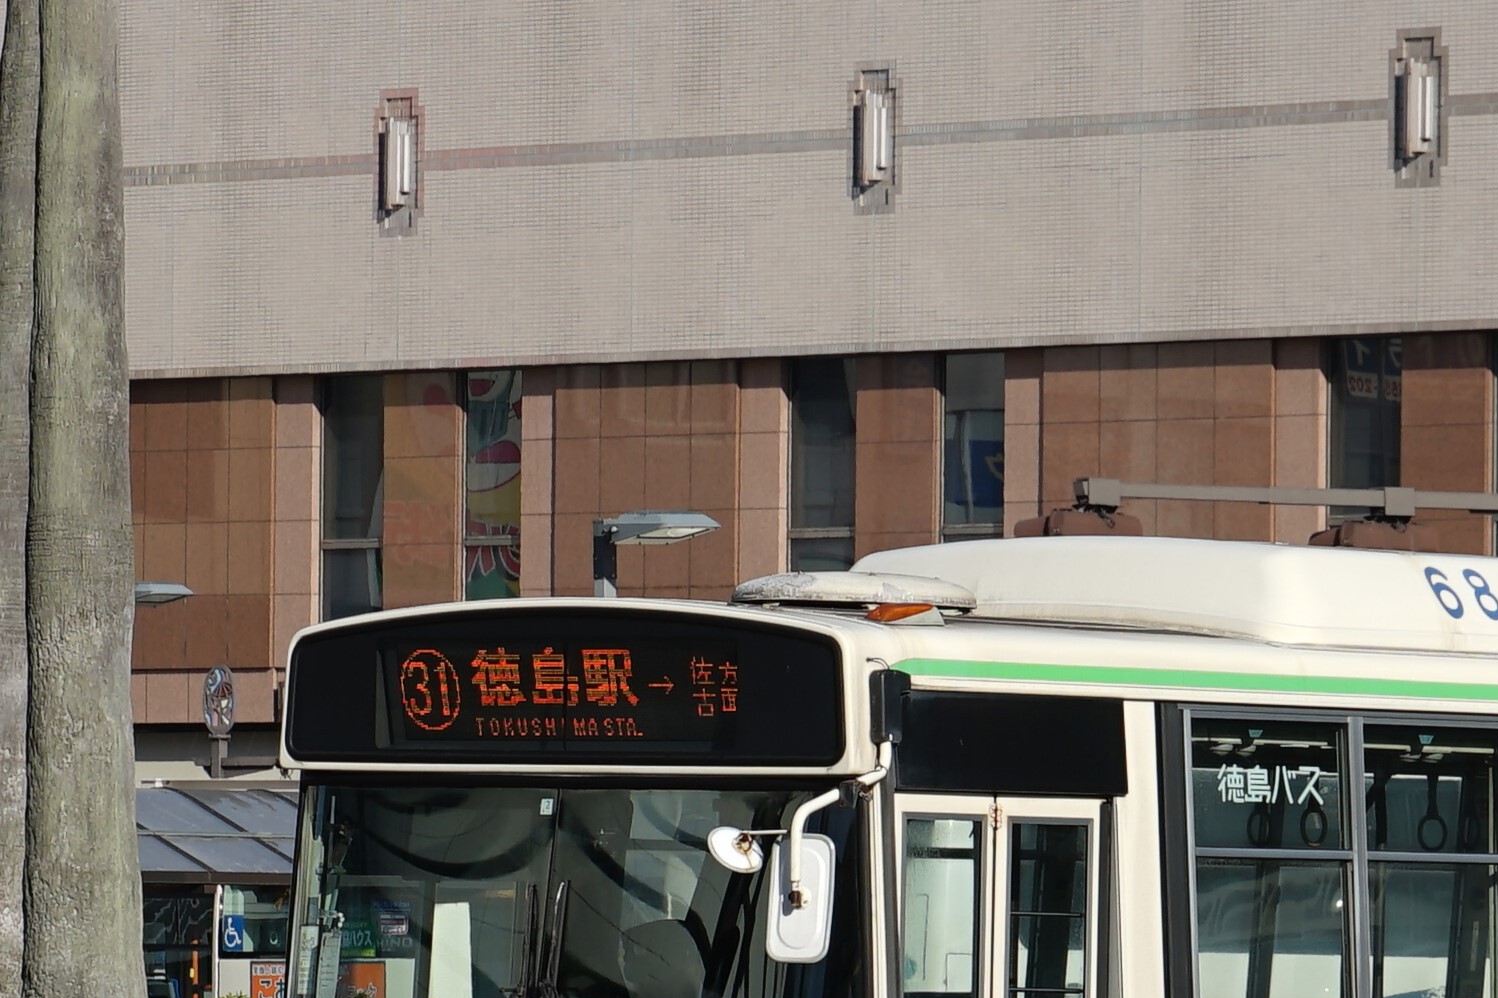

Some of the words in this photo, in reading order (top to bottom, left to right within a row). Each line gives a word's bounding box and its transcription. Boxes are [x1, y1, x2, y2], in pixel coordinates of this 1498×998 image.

[404, 661, 450, 716] 31
[472, 646, 639, 706] 徳島駅
[1218, 763, 1325, 806] 徳島バス
